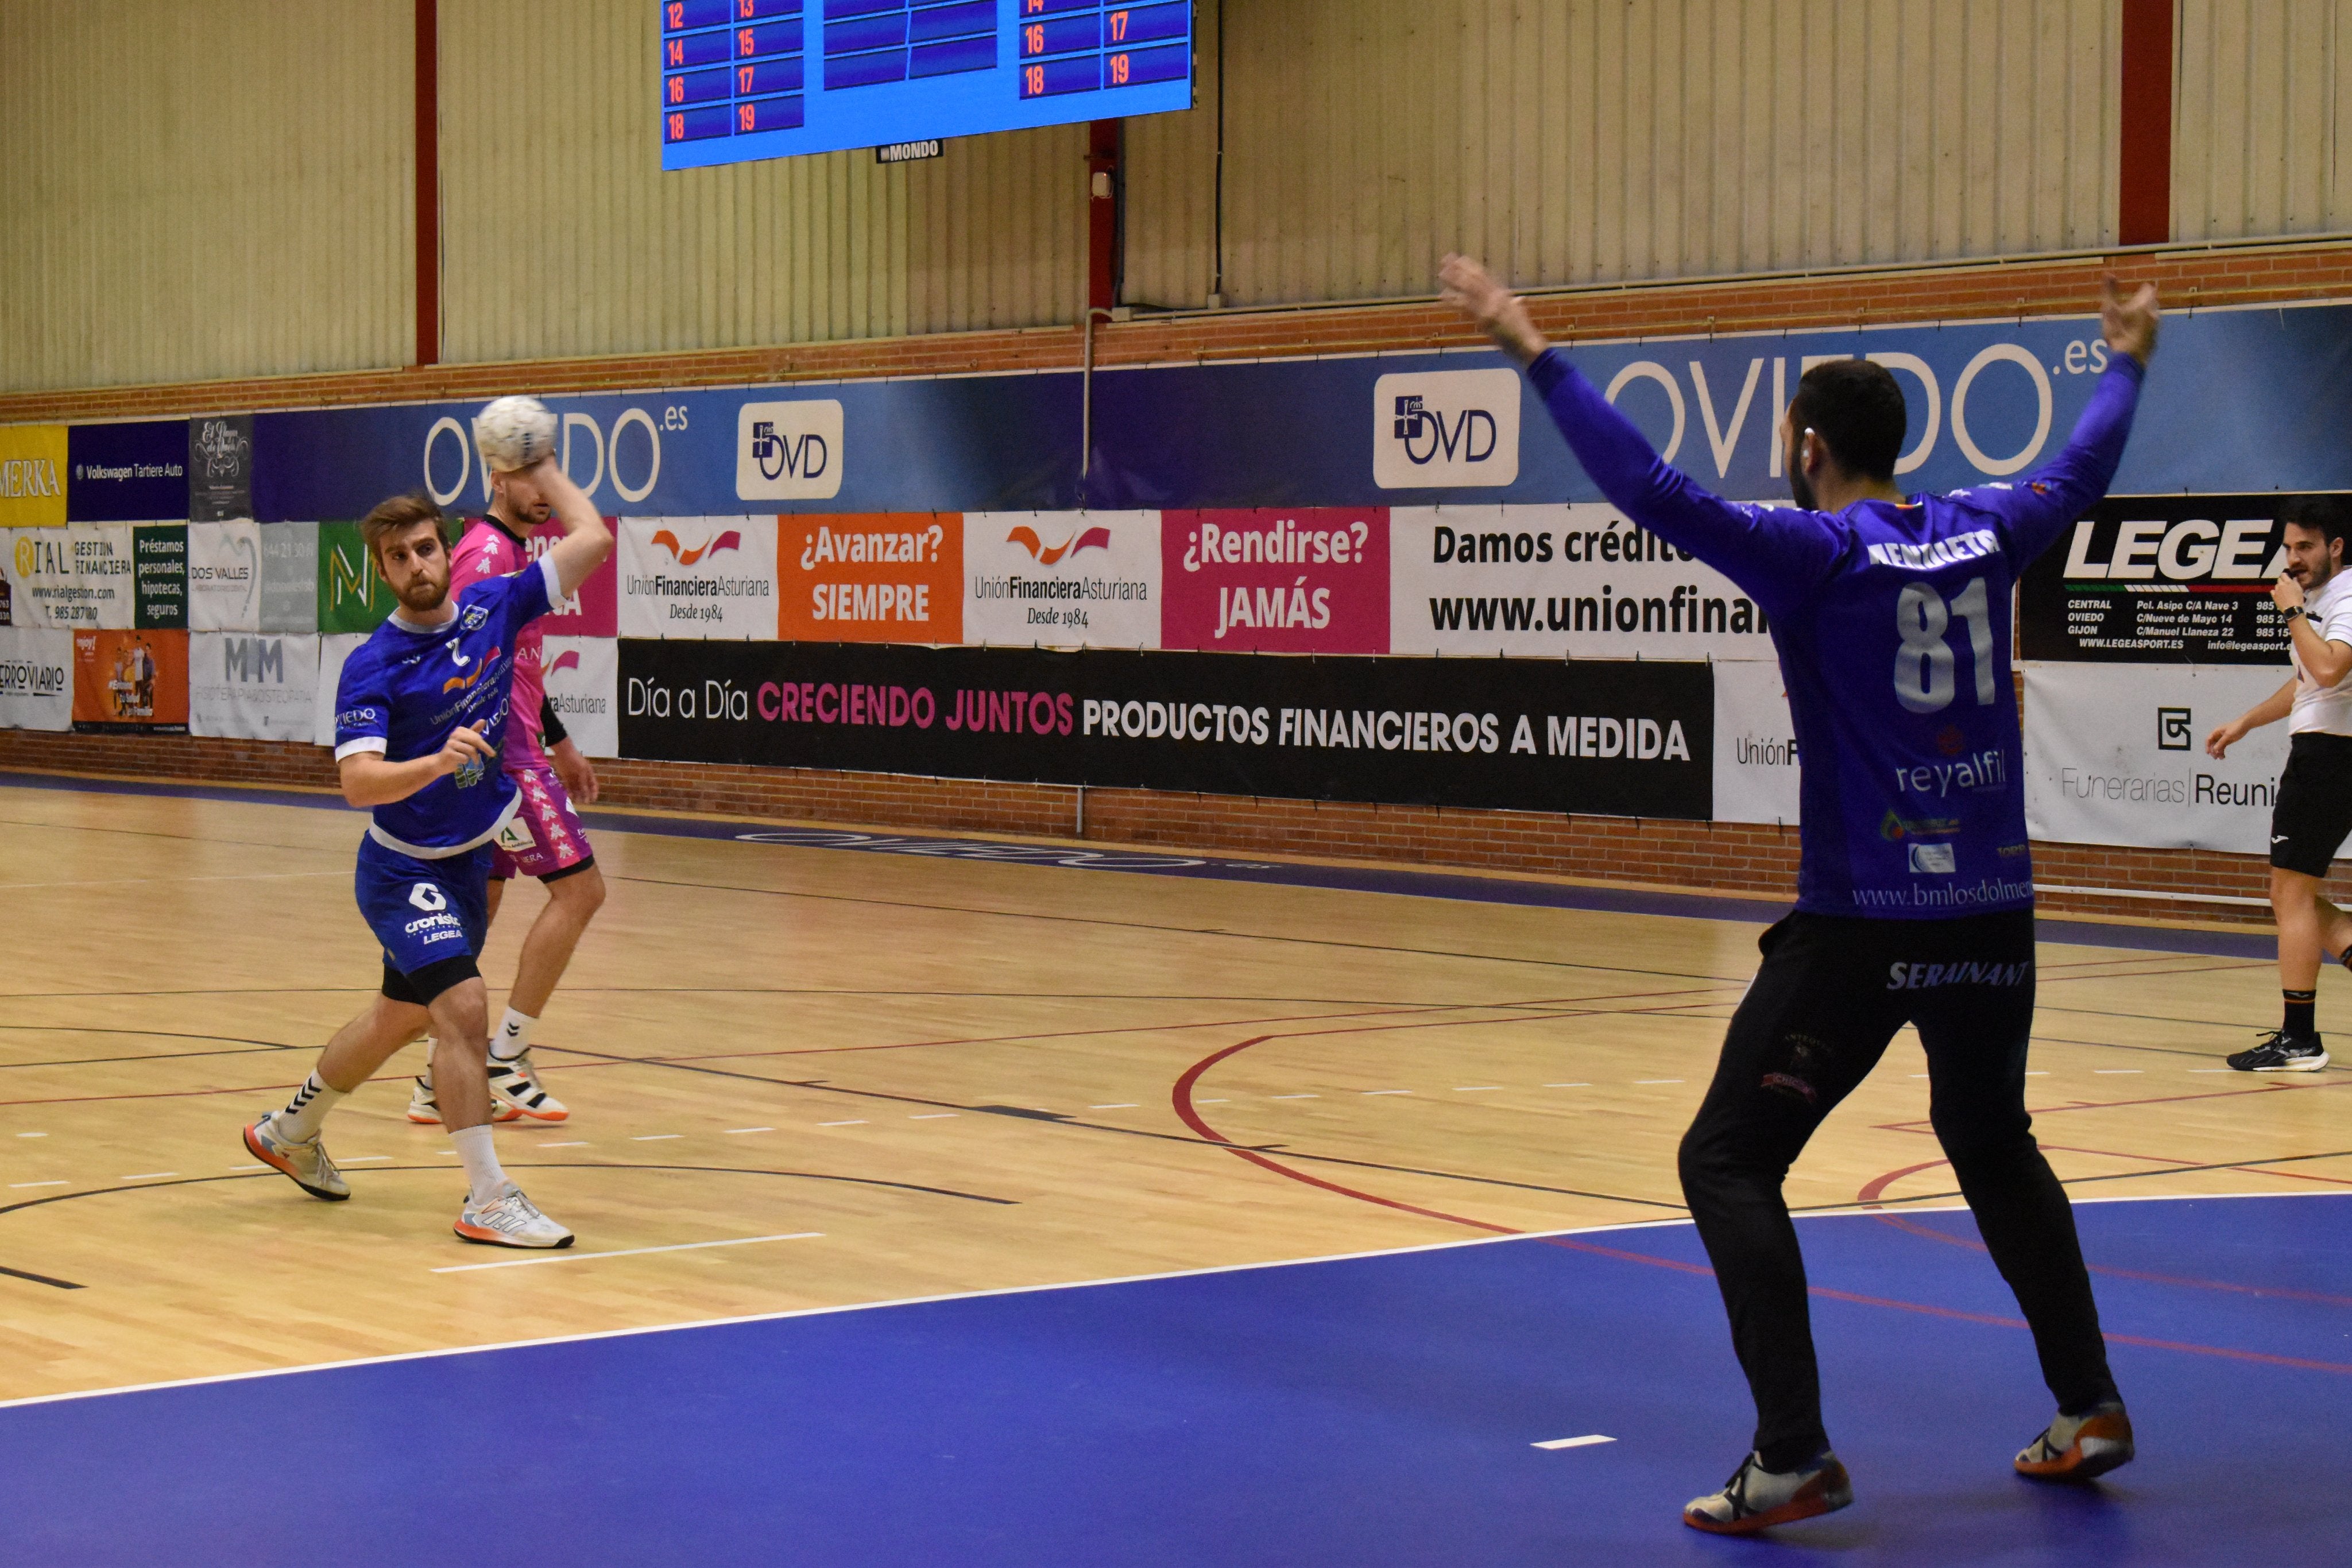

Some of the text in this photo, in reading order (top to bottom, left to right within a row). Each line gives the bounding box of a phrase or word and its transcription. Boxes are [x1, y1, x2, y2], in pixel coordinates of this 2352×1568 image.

[668, 3, 683, 28] 12
[1109, 11, 1129, 41] 17
[738, 28, 755, 56] 15
[1025, 24, 1045, 53] 16
[668, 40, 683, 65] 14
[738, 66, 754, 93] 17
[1025, 65, 1045, 95] 18
[1109, 54, 1129, 84] 19
[668, 76, 684, 102] 16
[669, 113, 684, 140] 18
[739, 104, 755, 131] 19
[889, 140, 939, 161] MONDO
[87, 462, 183, 482] Volkswagen Tartiere Auto
[140, 539, 184, 555] Préstamos
[801, 525, 943, 570] ¿Avanzar?
[1183, 520, 1368, 572] ¿Rendirse?
[1434, 525, 1553, 564] Damos
[138, 562, 185, 579] personales,
[191, 567, 248, 580] DOS VALLES
[141, 580, 183, 601] hipotecas,
[627, 574, 769, 597] UniónFinancieraAsturiana
[975, 576, 1147, 601] UniónFinancieraAsturiana
[146, 605, 179, 621] seguros
[670, 603, 723, 624] Desde 1984
[812, 584, 930, 622] SIEMPRE
[1214, 576, 1331, 638] JAMÁS
[2068, 600, 2112, 610] CENTRAL
[2157, 601, 2183, 611] Asipo
[2185, 601, 2203, 610] C/A
[2205, 602, 2229, 610] Nave
[2231, 601, 2238, 610] 3
[2256, 602, 2274, 610] 985
[1027, 608, 1089, 628] Desde 1984
[2068, 613, 2105, 622] OVIEDO
[2137, 614, 2175, 623] C/Nueve
[2177, 614, 2189, 624] de
[2221, 615, 2232, 623] 14
[2256, 615, 2274, 624] 985
[2068, 625, 2098, 634] GIJON
[2137, 627, 2234, 637] C/Manuel Llaneza 22
[2256, 628, 2274, 637] 985
[1894, 576, 1995, 714] 81
[2079, 638, 2184, 649] WWW.LEGEASPORT.ES
[2208, 640, 2292, 652] info@legeasport.e
[628, 677, 1690, 761] Día a Día CRECIENDO JUNTOS PRODUCTOS FINANCIEROS A MEDIDA
[1895, 749, 2006, 797] reyalfil
[423, 930, 463, 945] LEGEA
